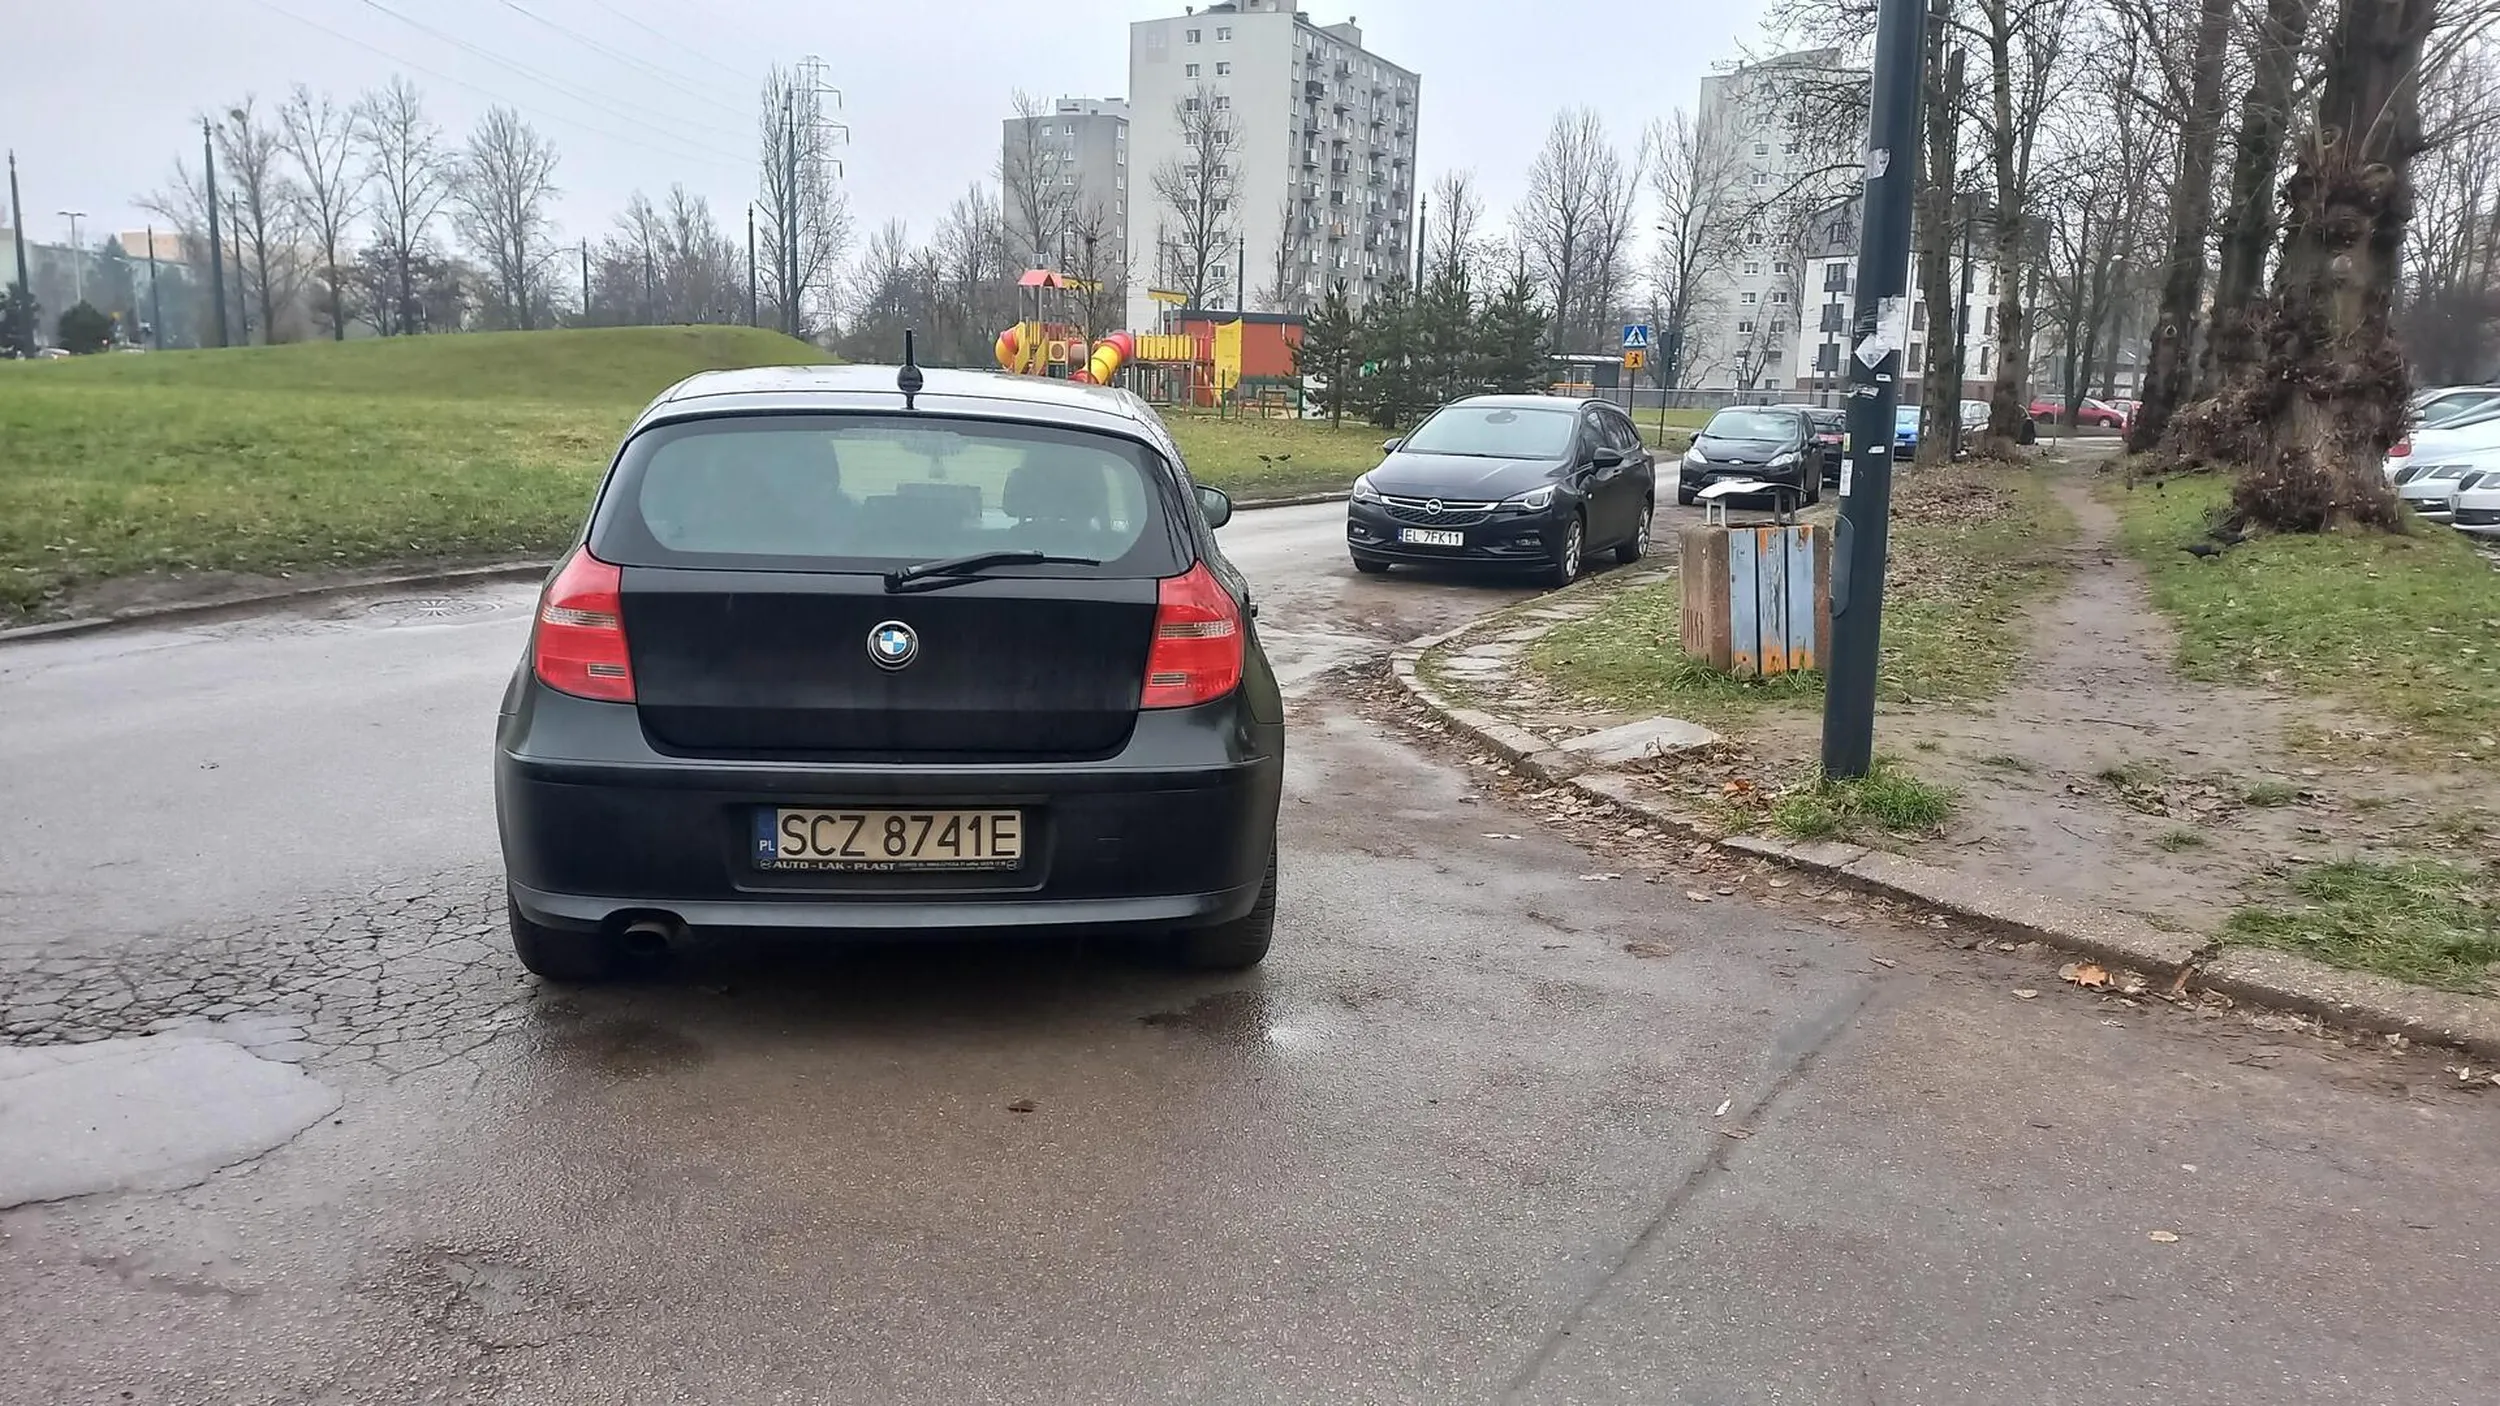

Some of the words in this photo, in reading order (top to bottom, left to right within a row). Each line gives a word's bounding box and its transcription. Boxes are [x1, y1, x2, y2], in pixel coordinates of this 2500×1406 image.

[1405, 529, 1419, 541] EL
[1424, 531, 1459, 544] 7FK11
[781, 814, 866, 857] SCZ
[883, 815, 1016, 857] 8741E
[759, 840, 776, 851] PL
[773, 860, 809, 870] AUTO
[819, 861, 844, 870] LAK
[854, 861, 896, 871] PLAST
